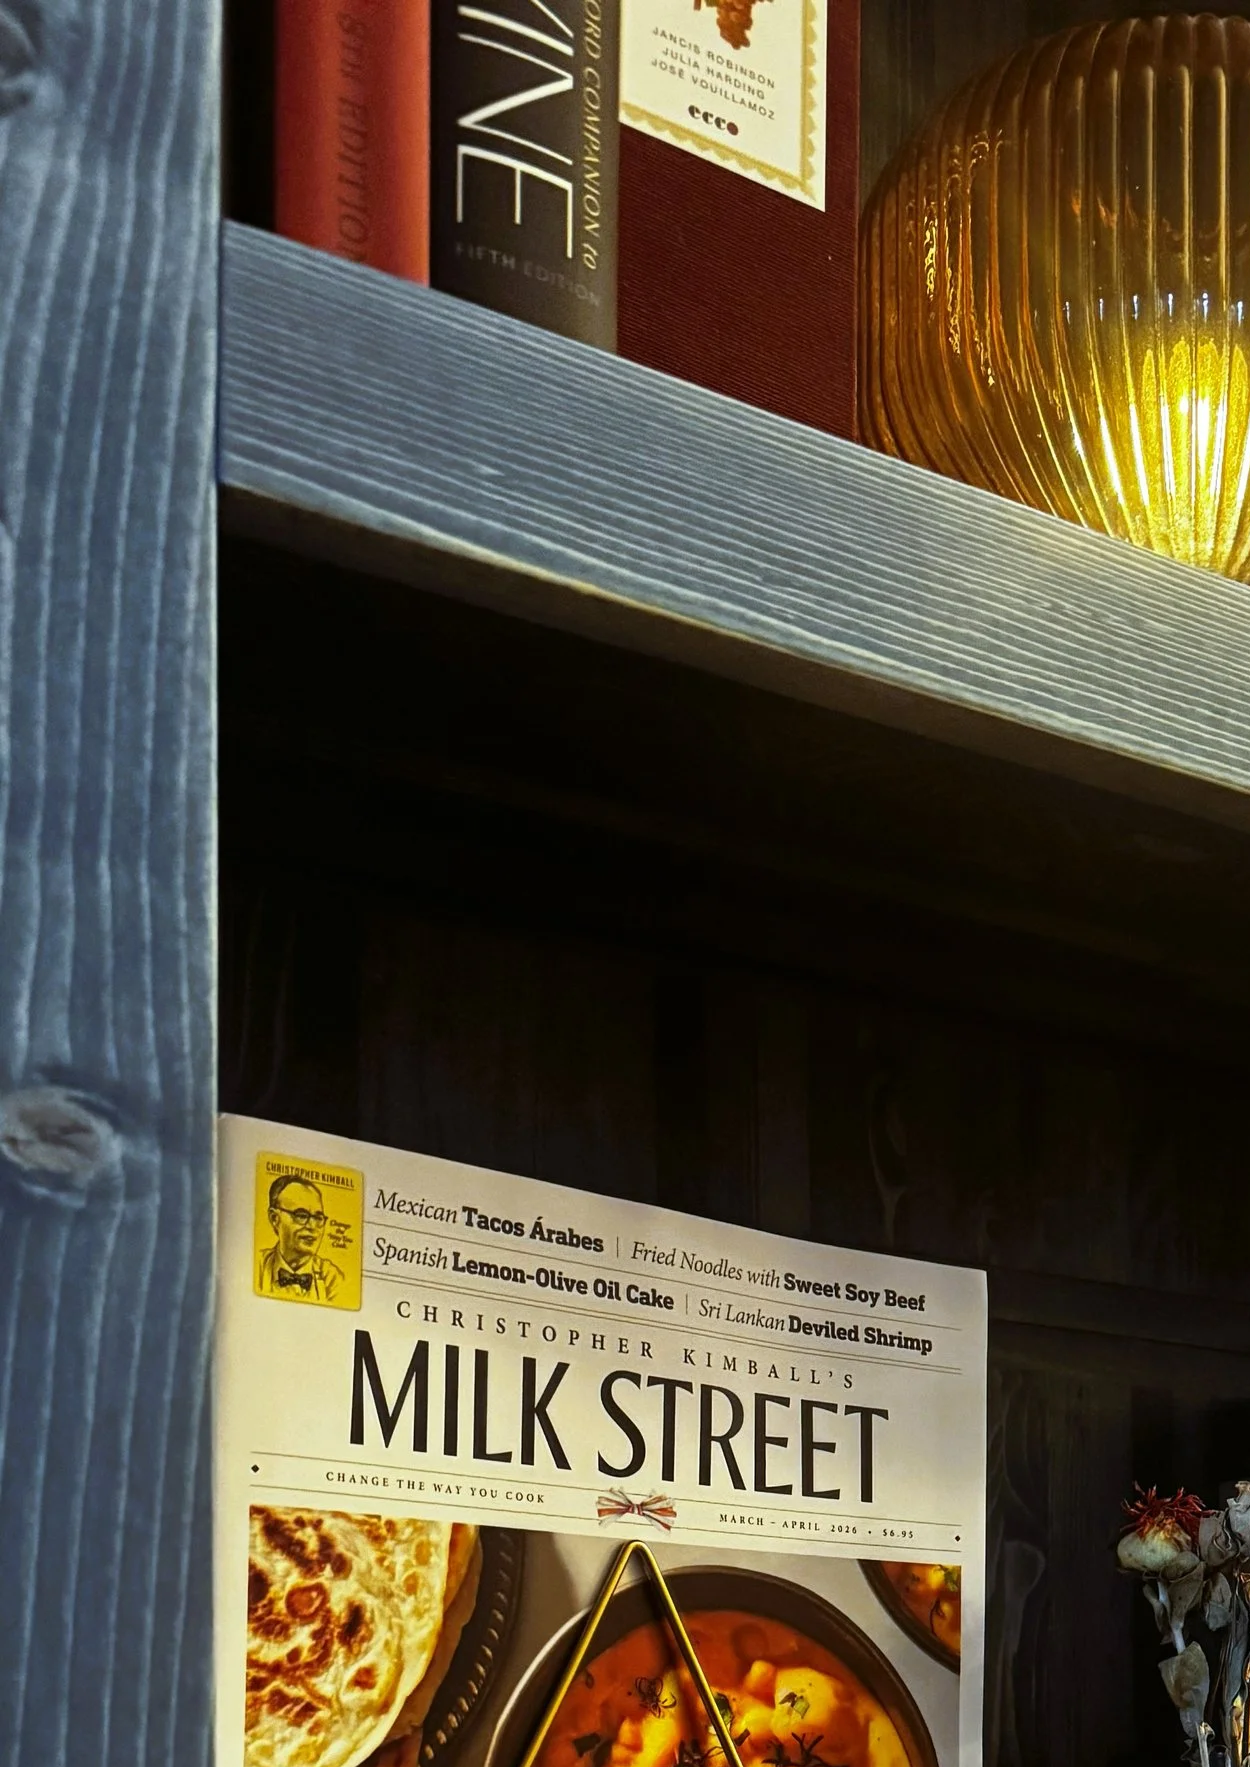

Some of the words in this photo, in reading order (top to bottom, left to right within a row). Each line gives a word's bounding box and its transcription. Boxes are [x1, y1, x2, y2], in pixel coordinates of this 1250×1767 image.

[583, 0, 602, 59] ORD
[652, 26, 700, 55] JANCIS
[707, 50, 776, 88] ROBINSON
[662, 48, 700, 69] JULIA
[707, 66, 766, 100] HARDING
[692, 75, 776, 120] VOUILLAMOZ
[458, 0, 574, 258] INE
[688, 104, 739, 136] ecco
[335, 97, 370, 263] EDITIO
[584, 66, 602, 237] COMPANION
[581, 242, 599, 270] to
[266, 1161, 319, 1181] CHRISTOPHER
[321, 1173, 355, 1188] KIMBALL
[374, 1189, 458, 1225] Mexican
[462, 1206, 525, 1238] Tacos
[529, 1215, 604, 1253] Árabes
[373, 1237, 448, 1271] Spanish
[452, 1251, 589, 1299] Lemon-Olive
[593, 1278, 621, 1302] Oil
[626, 1284, 675, 1311] Cake
[631, 1241, 676, 1268] Fried
[680, 1250, 743, 1282] Noodles
[747, 1265, 781, 1289] with
[784, 1273, 841, 1300] Sweet
[845, 1283, 880, 1308] Soy
[884, 1288, 926, 1312] Beef
[396, 1301, 653, 1359] CHRISTOPHER
[698, 1298, 722, 1318] Sri
[725, 1303, 786, 1331] Lankan
[788, 1314, 860, 1343] Deviled
[863, 1326, 933, 1355] Shrimp
[350, 1329, 572, 1471] MILK
[598, 1369, 889, 1503] STREET
[325, 1470, 391, 1489] CHANGE
[396, 1478, 426, 1491] THE
[432, 1483, 463, 1496] WAY
[470, 1487, 499, 1499] YOU
[505, 1491, 545, 1504] COOK
[719, 1513, 764, 1526] MARCH
[782, 1519, 821, 1532] APRIL
[830, 1523, 858, 1535] 2026
[882, 1527, 915, 1540] $6.95
